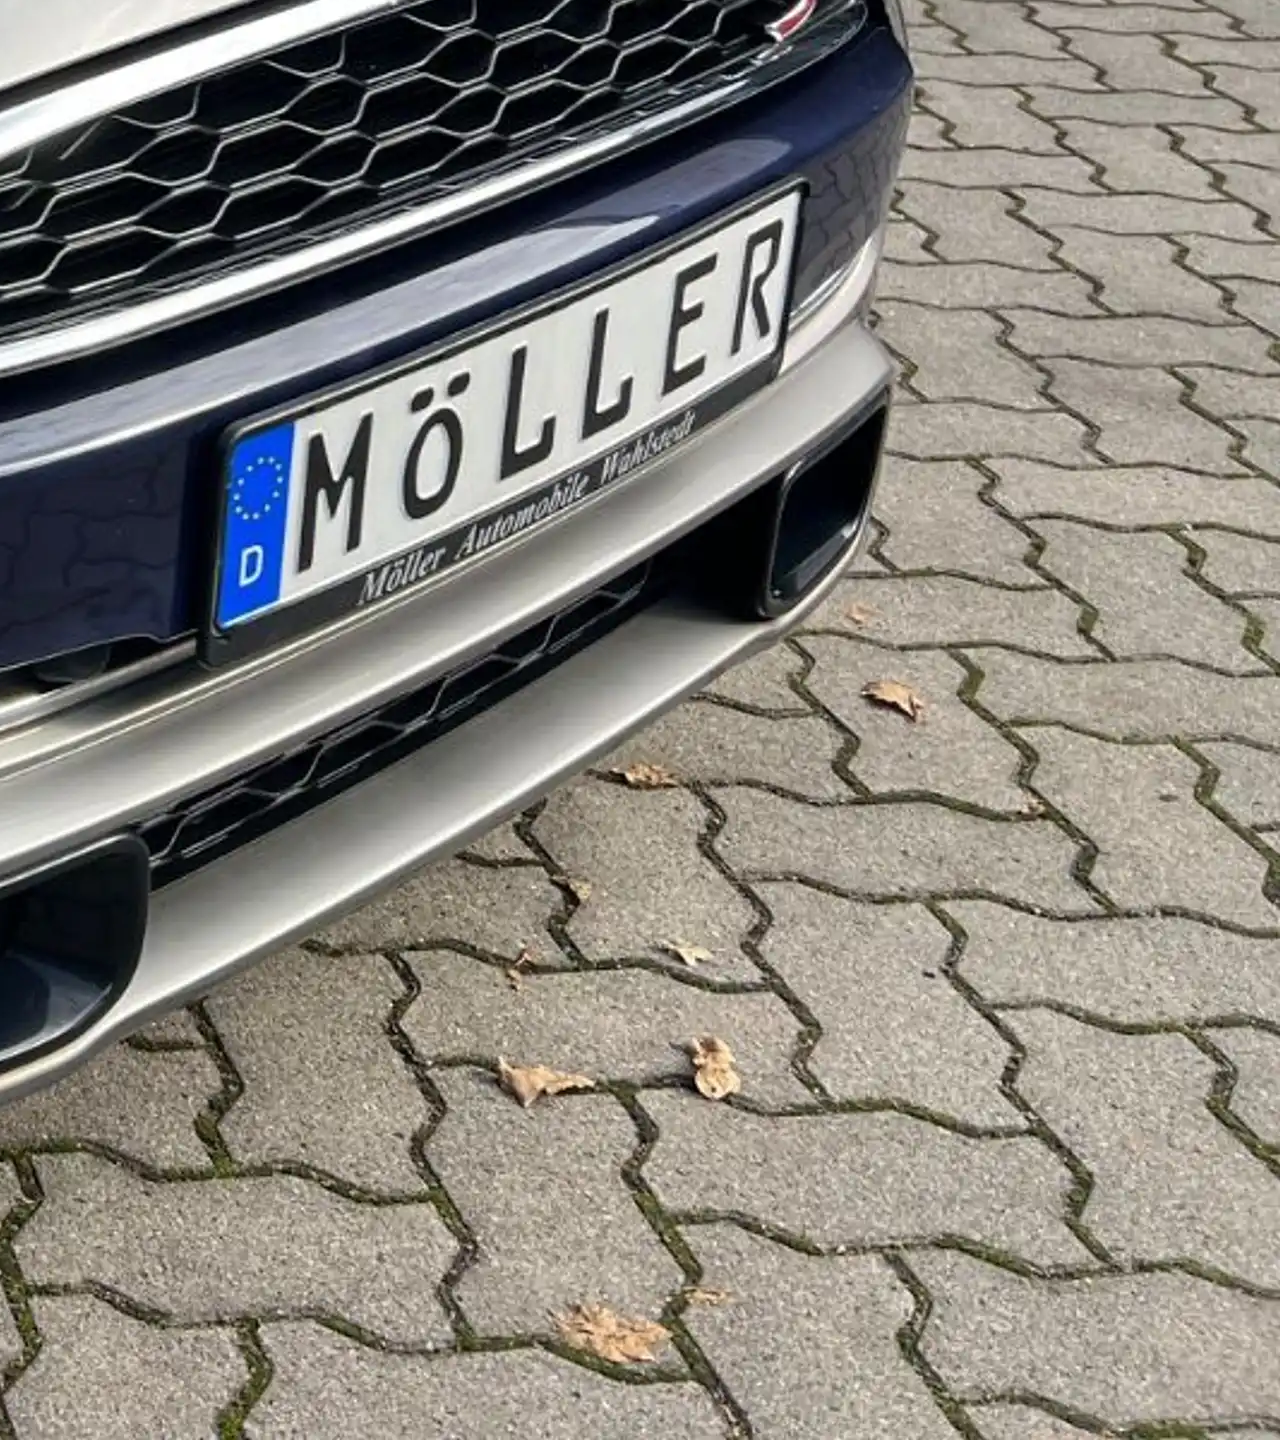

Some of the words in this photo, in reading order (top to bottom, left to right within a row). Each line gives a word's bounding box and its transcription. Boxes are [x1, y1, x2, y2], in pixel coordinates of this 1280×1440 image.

[296, 218, 783, 573] MÖLLER
[239, 544, 263, 587] D
[355, 546, 446, 606] Möller
[454, 471, 589, 560] Automobile
